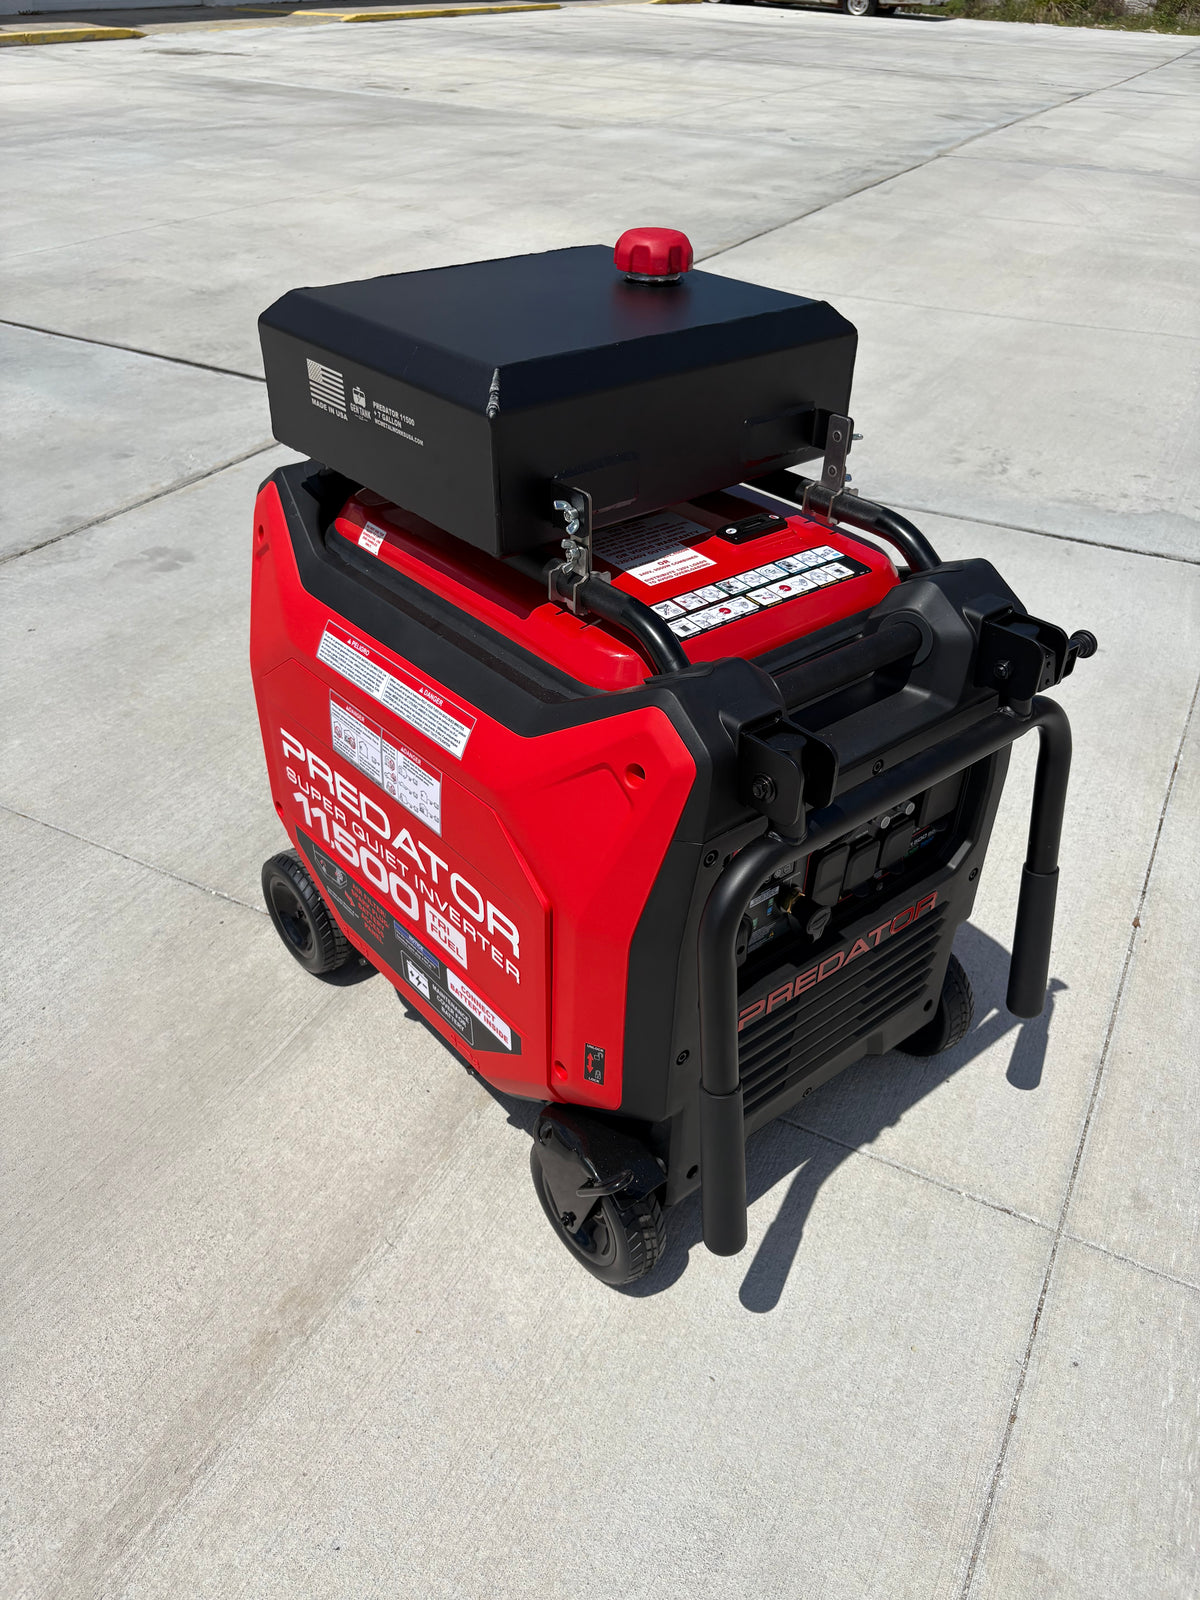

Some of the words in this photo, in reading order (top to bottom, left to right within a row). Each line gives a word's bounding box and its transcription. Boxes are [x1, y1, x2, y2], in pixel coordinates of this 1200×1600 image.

[311, 398, 328, 412] MADE
[328, 406, 335, 415] IN
[335, 408, 348, 421] USA
[372, 400, 400, 419] PREDATOR
[400, 413, 415, 427] 11500
[381, 414, 402, 428] GALLON
[350, 640, 370, 656] PELIGRO
[423, 689, 444, 707] DANGER
[404, 749, 422, 766] DANGER
[280, 727, 520, 960] PREDATOR
[292, 791, 420, 921] 11,500
[285, 766, 347, 827] SUPER
[352, 821, 409, 877] QUIET
[414, 874, 520, 985] INVERTER
[429, 911, 450, 936] TRI
[430, 923, 464, 961] FUEL
[737, 890, 938, 1033] PREDATOR
[432, 983, 470, 1024] MAINTENANCE
[436, 994, 455, 1014] COVER
[455, 1011, 467, 1027] FOR
[441, 1006, 465, 1032] BATTERY
[449, 982, 482, 1016] BATTERY
[483, 1015, 509, 1045] INSIDE
[460, 985, 497, 1022] CONNECT
